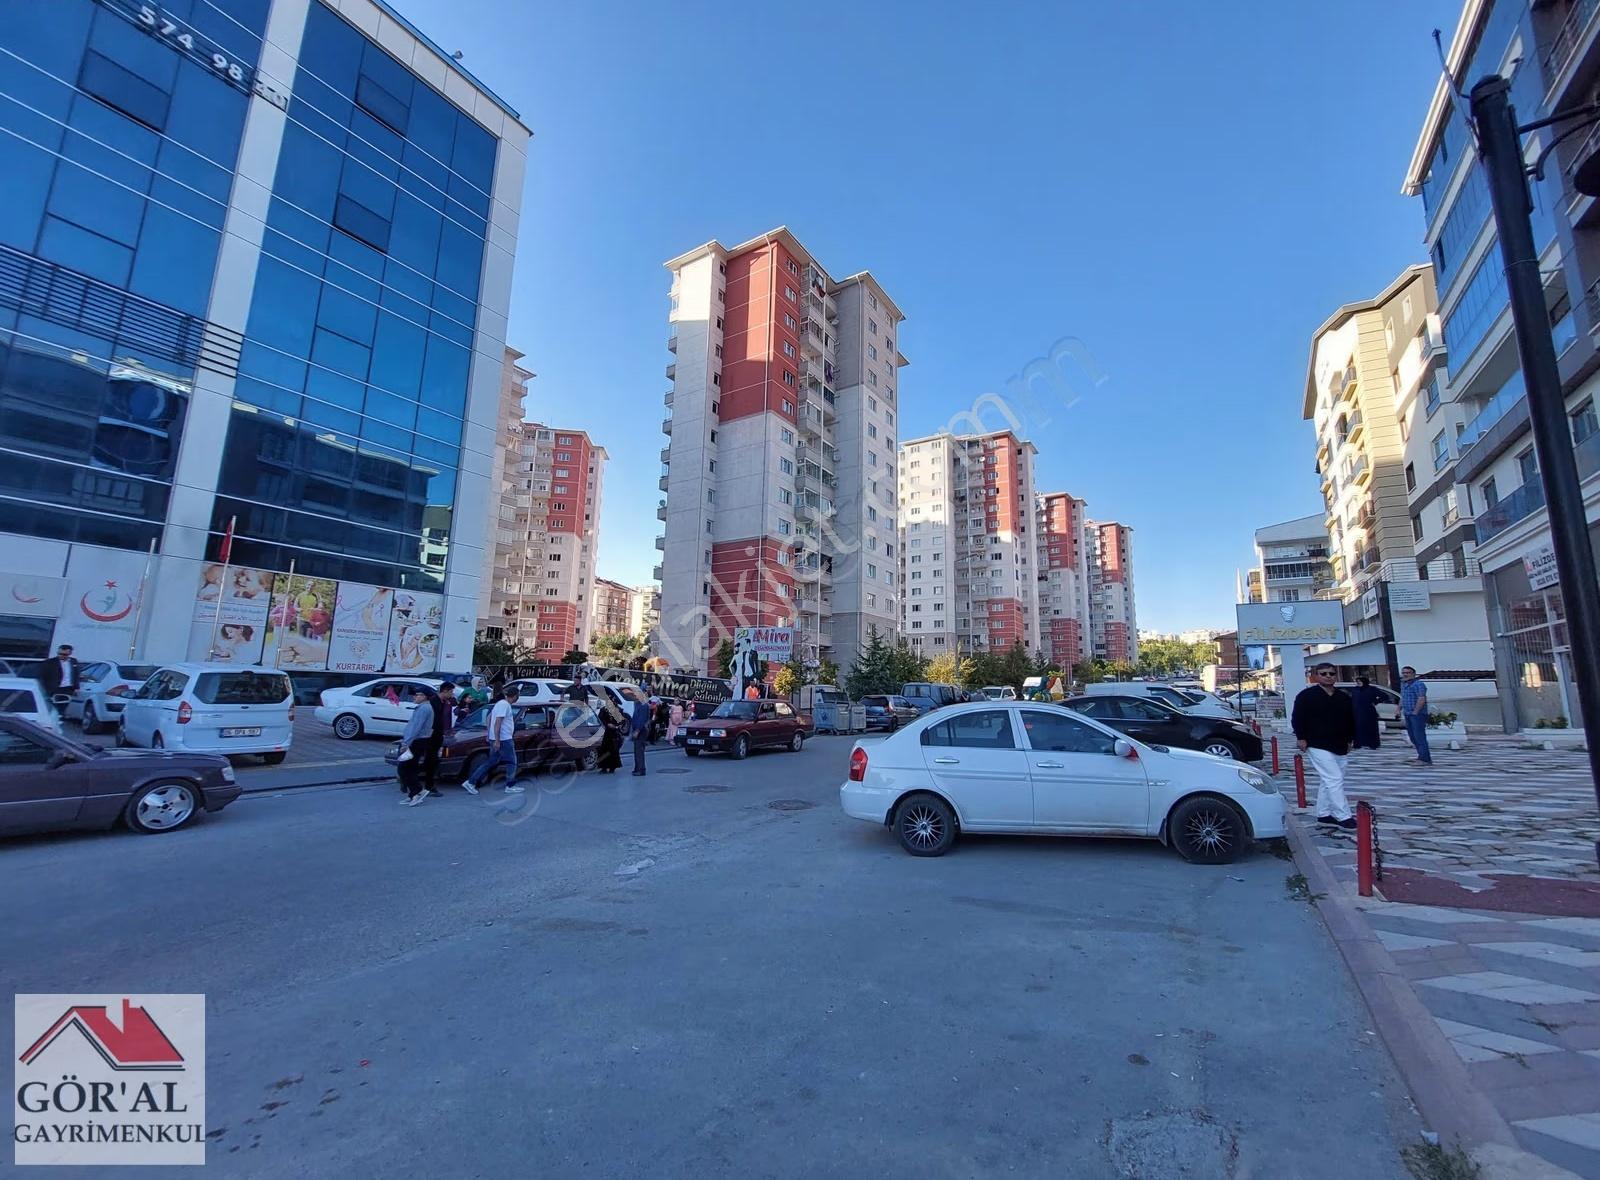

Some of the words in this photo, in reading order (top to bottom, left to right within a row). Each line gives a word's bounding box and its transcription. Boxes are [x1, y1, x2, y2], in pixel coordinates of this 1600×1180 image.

[138, 5, 193, 49] 574
[212, 53, 243, 81] 98
[516, 666, 536, 677] Yeni
[537, 666, 560, 678] Mira
